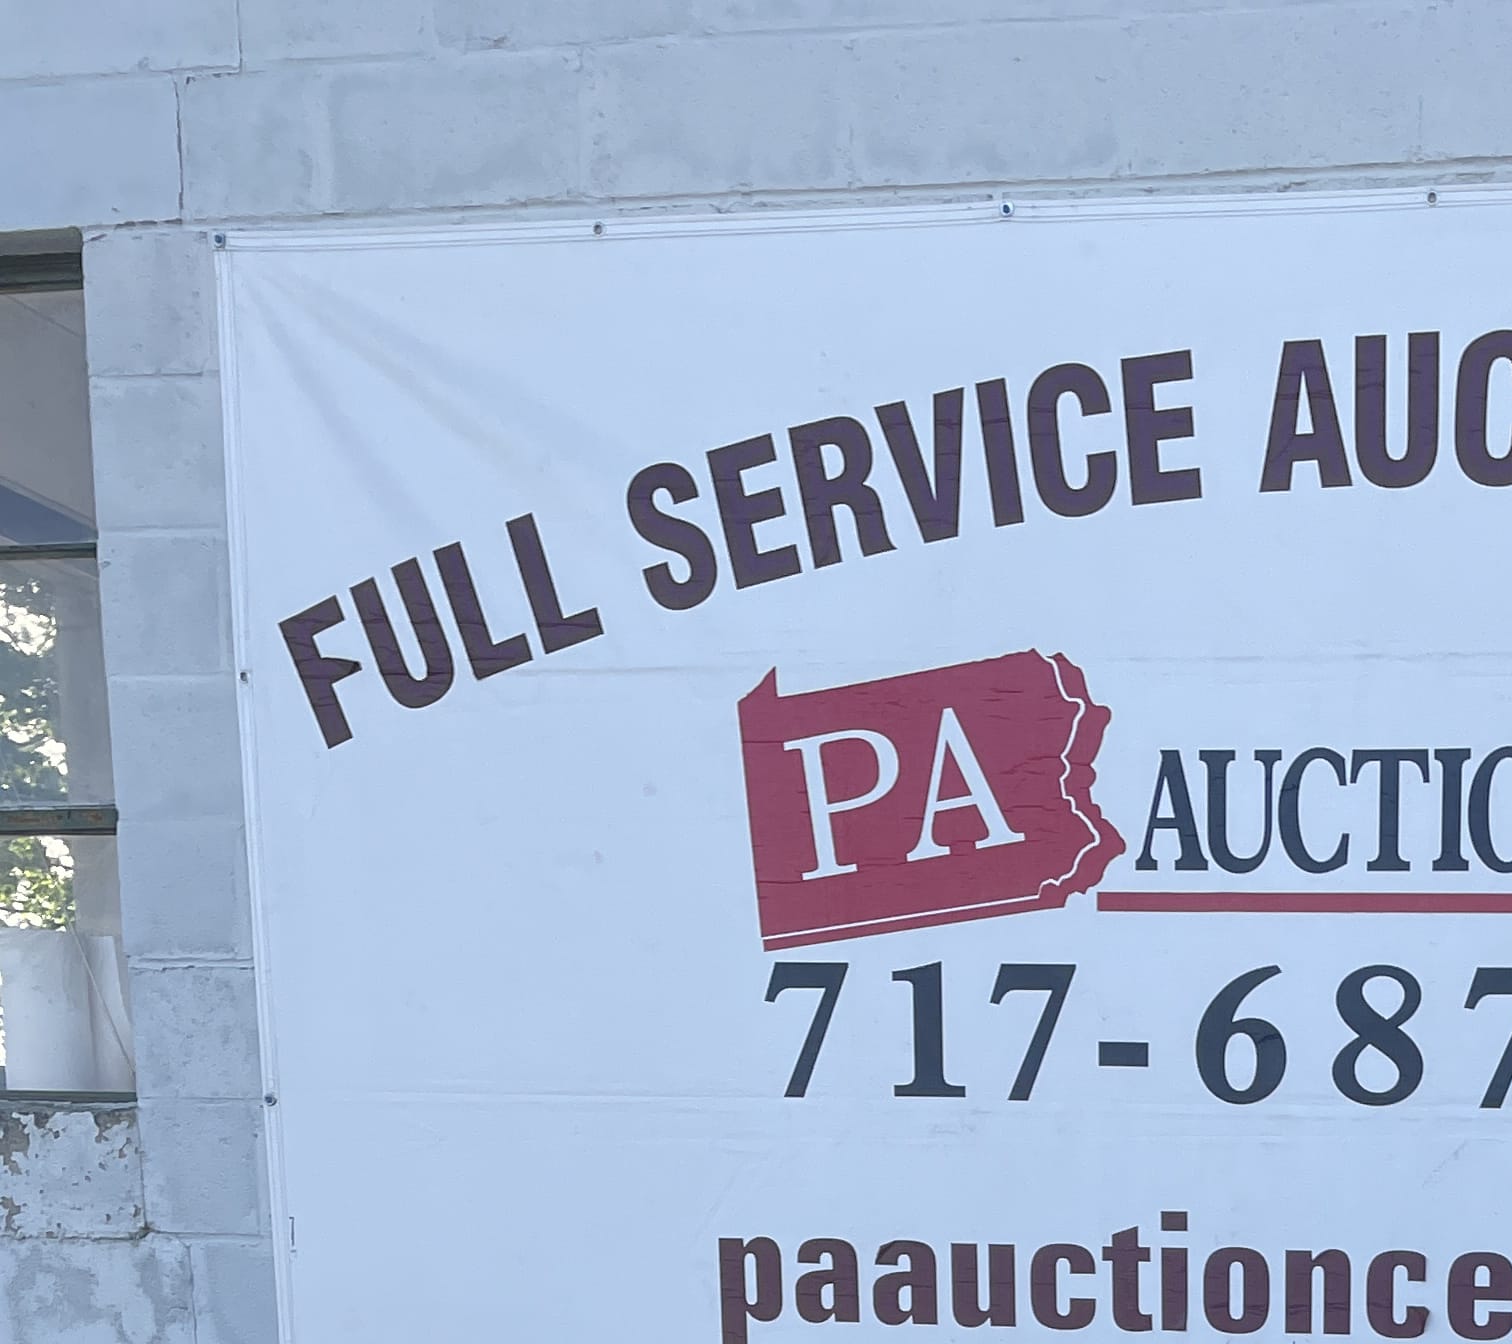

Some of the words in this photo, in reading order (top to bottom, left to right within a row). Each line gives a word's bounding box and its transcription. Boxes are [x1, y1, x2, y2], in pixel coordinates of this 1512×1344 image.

[278, 512, 605, 750] FULL
[625, 349, 1203, 611] SERVICE
[782, 706, 1026, 881] PA
